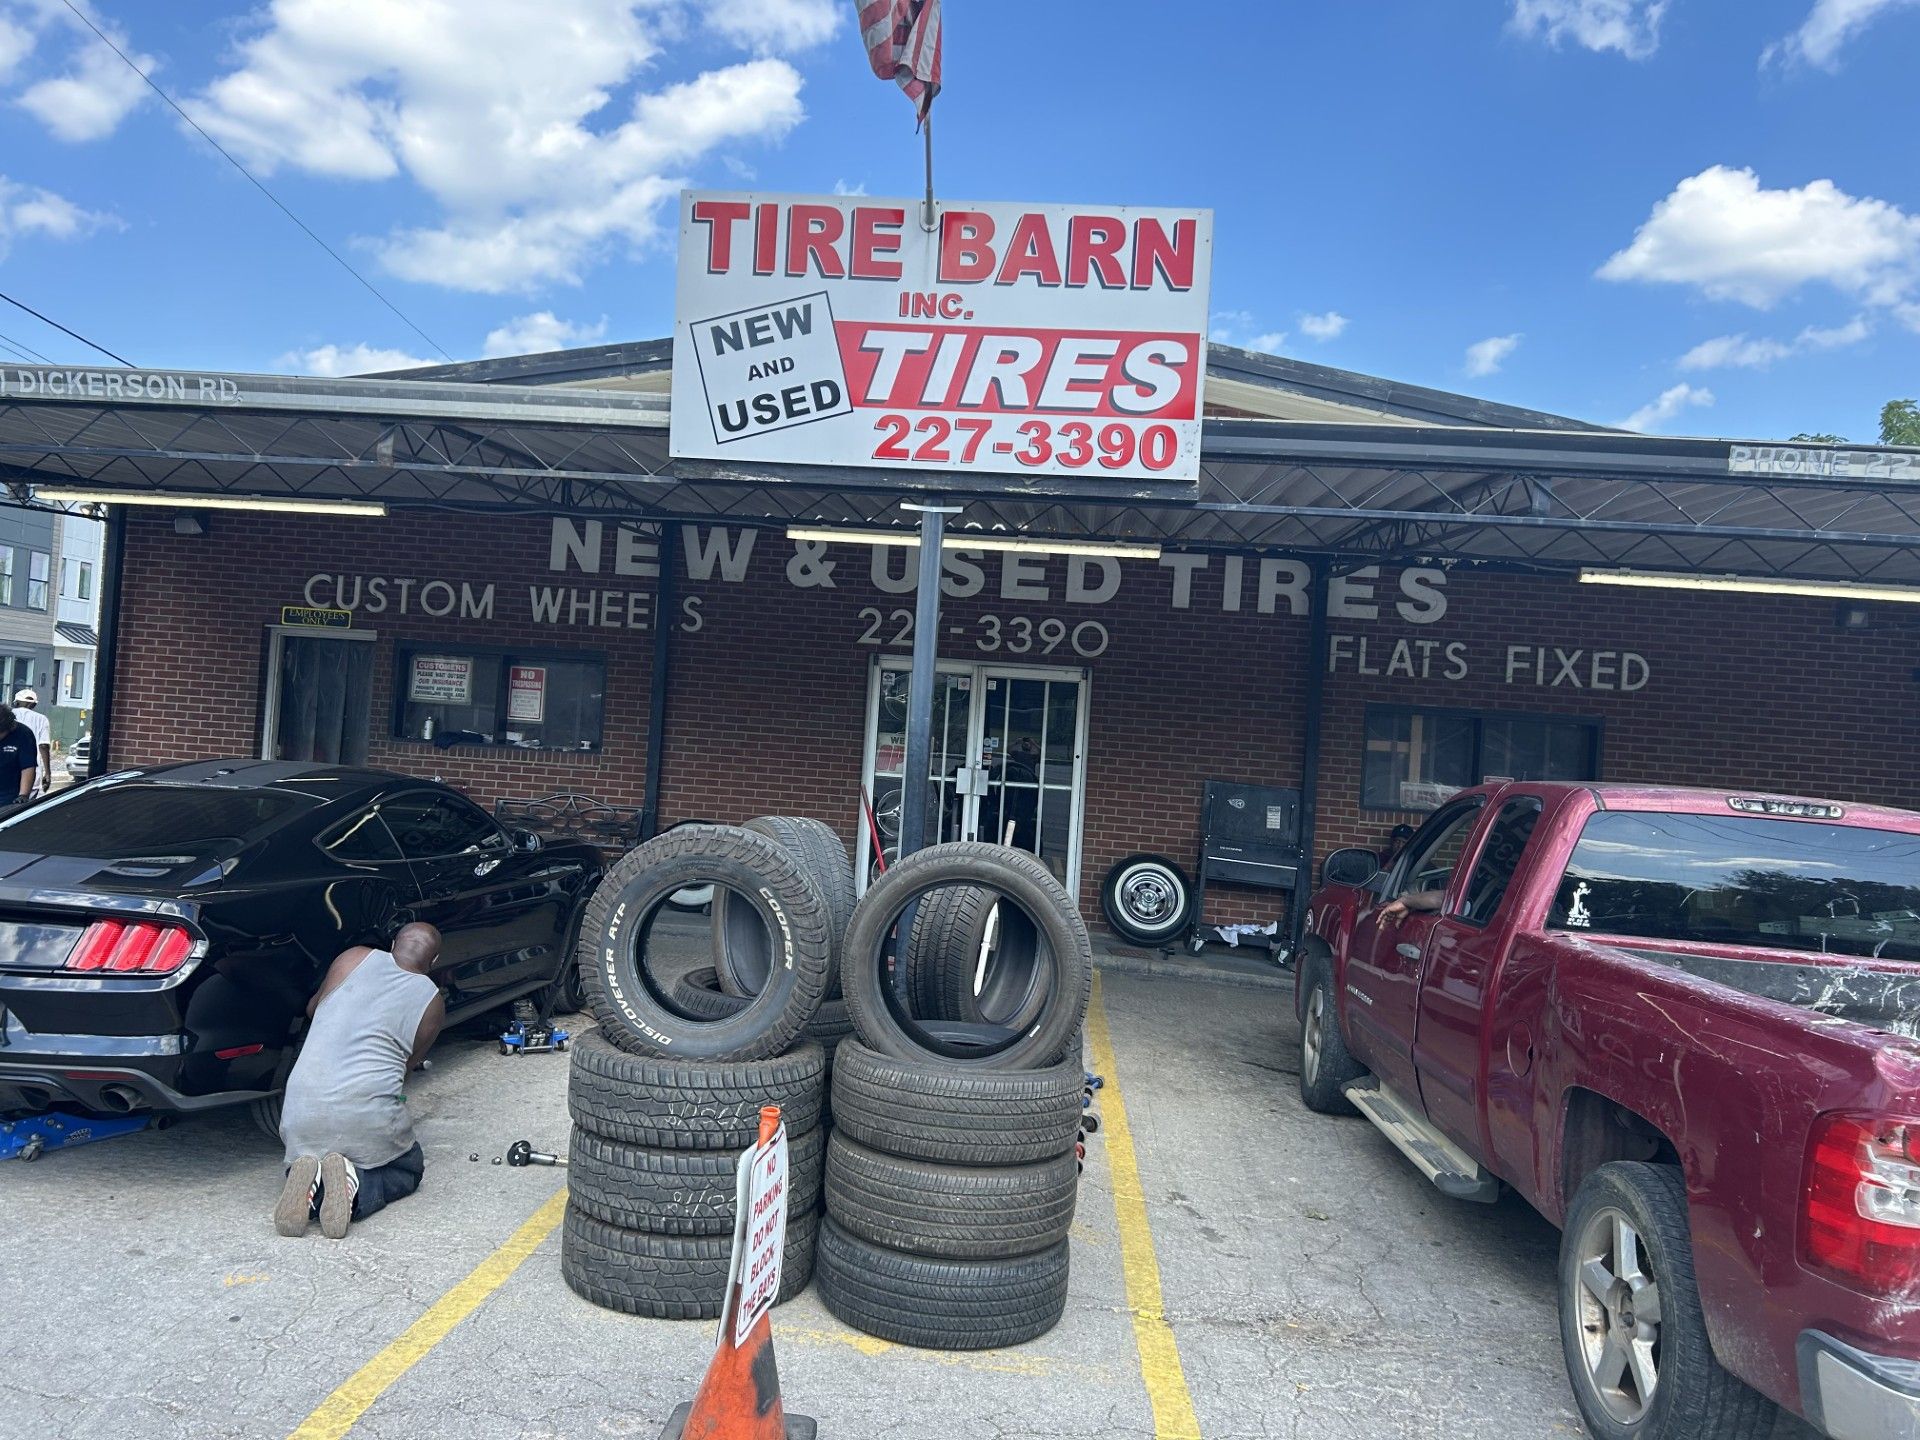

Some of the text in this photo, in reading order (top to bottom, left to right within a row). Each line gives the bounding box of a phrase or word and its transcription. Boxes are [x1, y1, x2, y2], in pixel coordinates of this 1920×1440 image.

[692, 201, 1197, 291] TIRE BARN
[710, 303, 813, 356] NEW
[899, 292, 974, 320] INC.
[17, 369, 186, 400] DICKERSON
[747, 355, 796, 382] AND
[859, 330, 1189, 415] TIRES
[717, 379, 842, 433] USED
[871, 415, 1178, 470] 227-3390
[1730, 446, 1920, 480] PHONE 22
[549, 516, 1449, 625] NEW & USED TIRES
[304, 573, 496, 620] CUSTOM
[302, 617, 329, 625] ONLY
[857, 607, 1109, 658] 22-3390
[418, 661, 466, 672] CUSTOMERS
[520, 670, 536, 680] NO
[1328, 635, 1651, 692] FLATS FIXED
[758, 886, 794, 970] COOPER
[605, 902, 673, 1046] DISCOVERER ATP
[766, 1153, 777, 1180] NO
[752, 1175, 783, 1223] PARKING
[752, 1207, 780, 1253] DO NOT
[750, 1243, 776, 1284] BLOCK
[742, 1266, 776, 1319] THE BAYS
